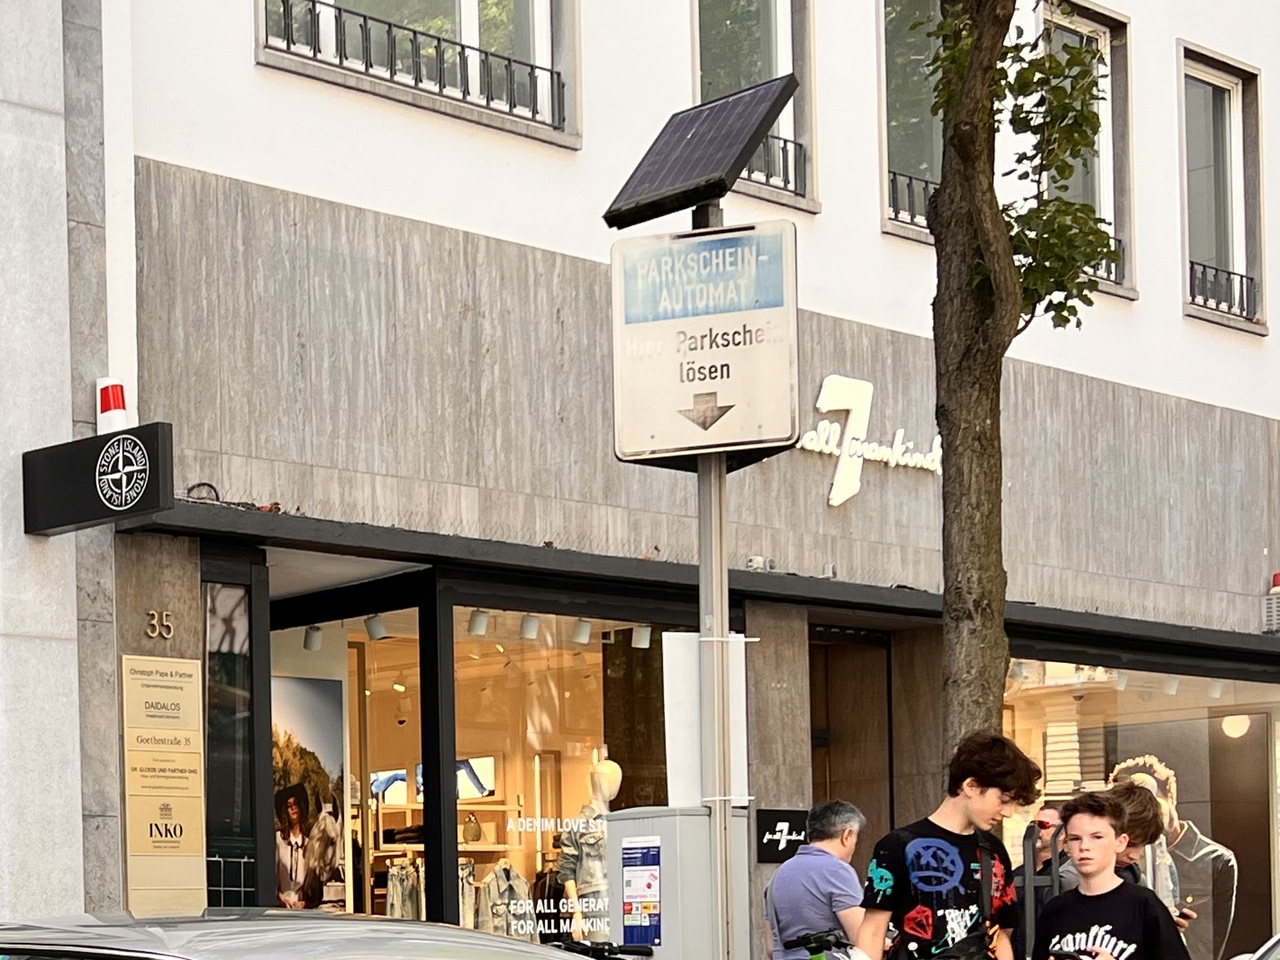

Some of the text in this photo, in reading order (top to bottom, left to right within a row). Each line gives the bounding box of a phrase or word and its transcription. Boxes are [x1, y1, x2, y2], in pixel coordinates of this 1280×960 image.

[637, 246, 769, 285] PARKSCHEIN-
[658, 280, 749, 312] AUTOMAT
[679, 361, 732, 384] lösen
[815, 374, 874, 507] 7
[100, 439, 146, 473] STONE ISLAND
[146, 609, 174, 639] 35
[129, 668, 154, 677] Christoph
[169, 670, 174, 678] &
[174, 670, 194, 679] Partner
[144, 701, 181, 712] DAIDALOS
[136, 734, 192, 747] Goethestraße 35
[149, 822, 184, 839] INKO
[506, 819, 516, 832] A
[519, 818, 555, 833] DENIM
[557, 819, 585, 833] LOVE
[510, 899, 534, 914] FOR
[536, 898, 558, 914] ALL
[510, 919, 534, 935] FOR
[536, 918, 559, 934] ALL
